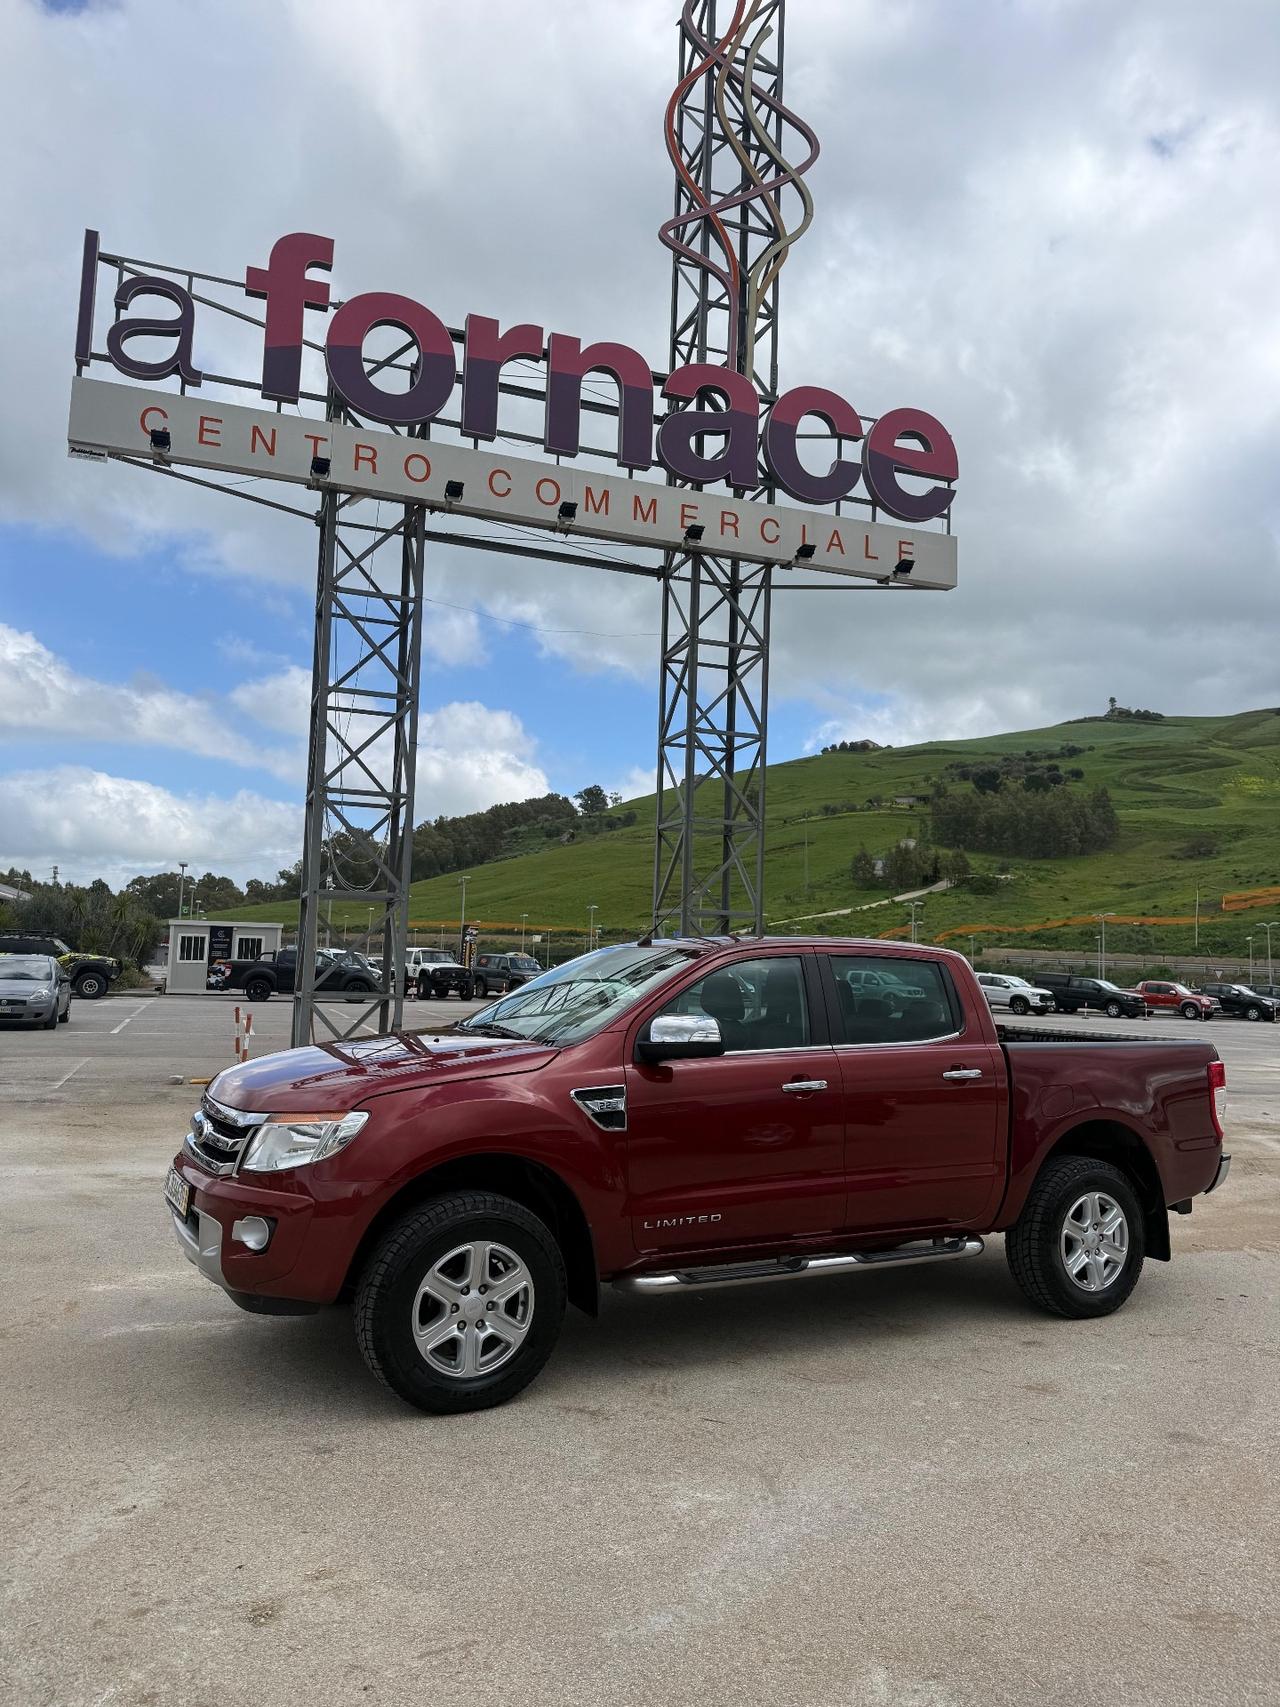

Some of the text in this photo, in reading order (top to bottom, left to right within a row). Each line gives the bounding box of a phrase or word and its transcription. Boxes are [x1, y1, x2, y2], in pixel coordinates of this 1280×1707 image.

[75, 228, 959, 523] la fornace
[140, 406, 916, 562] CENTRO COMMERCIALE
[644, 1213, 722, 1229] LIMITED
